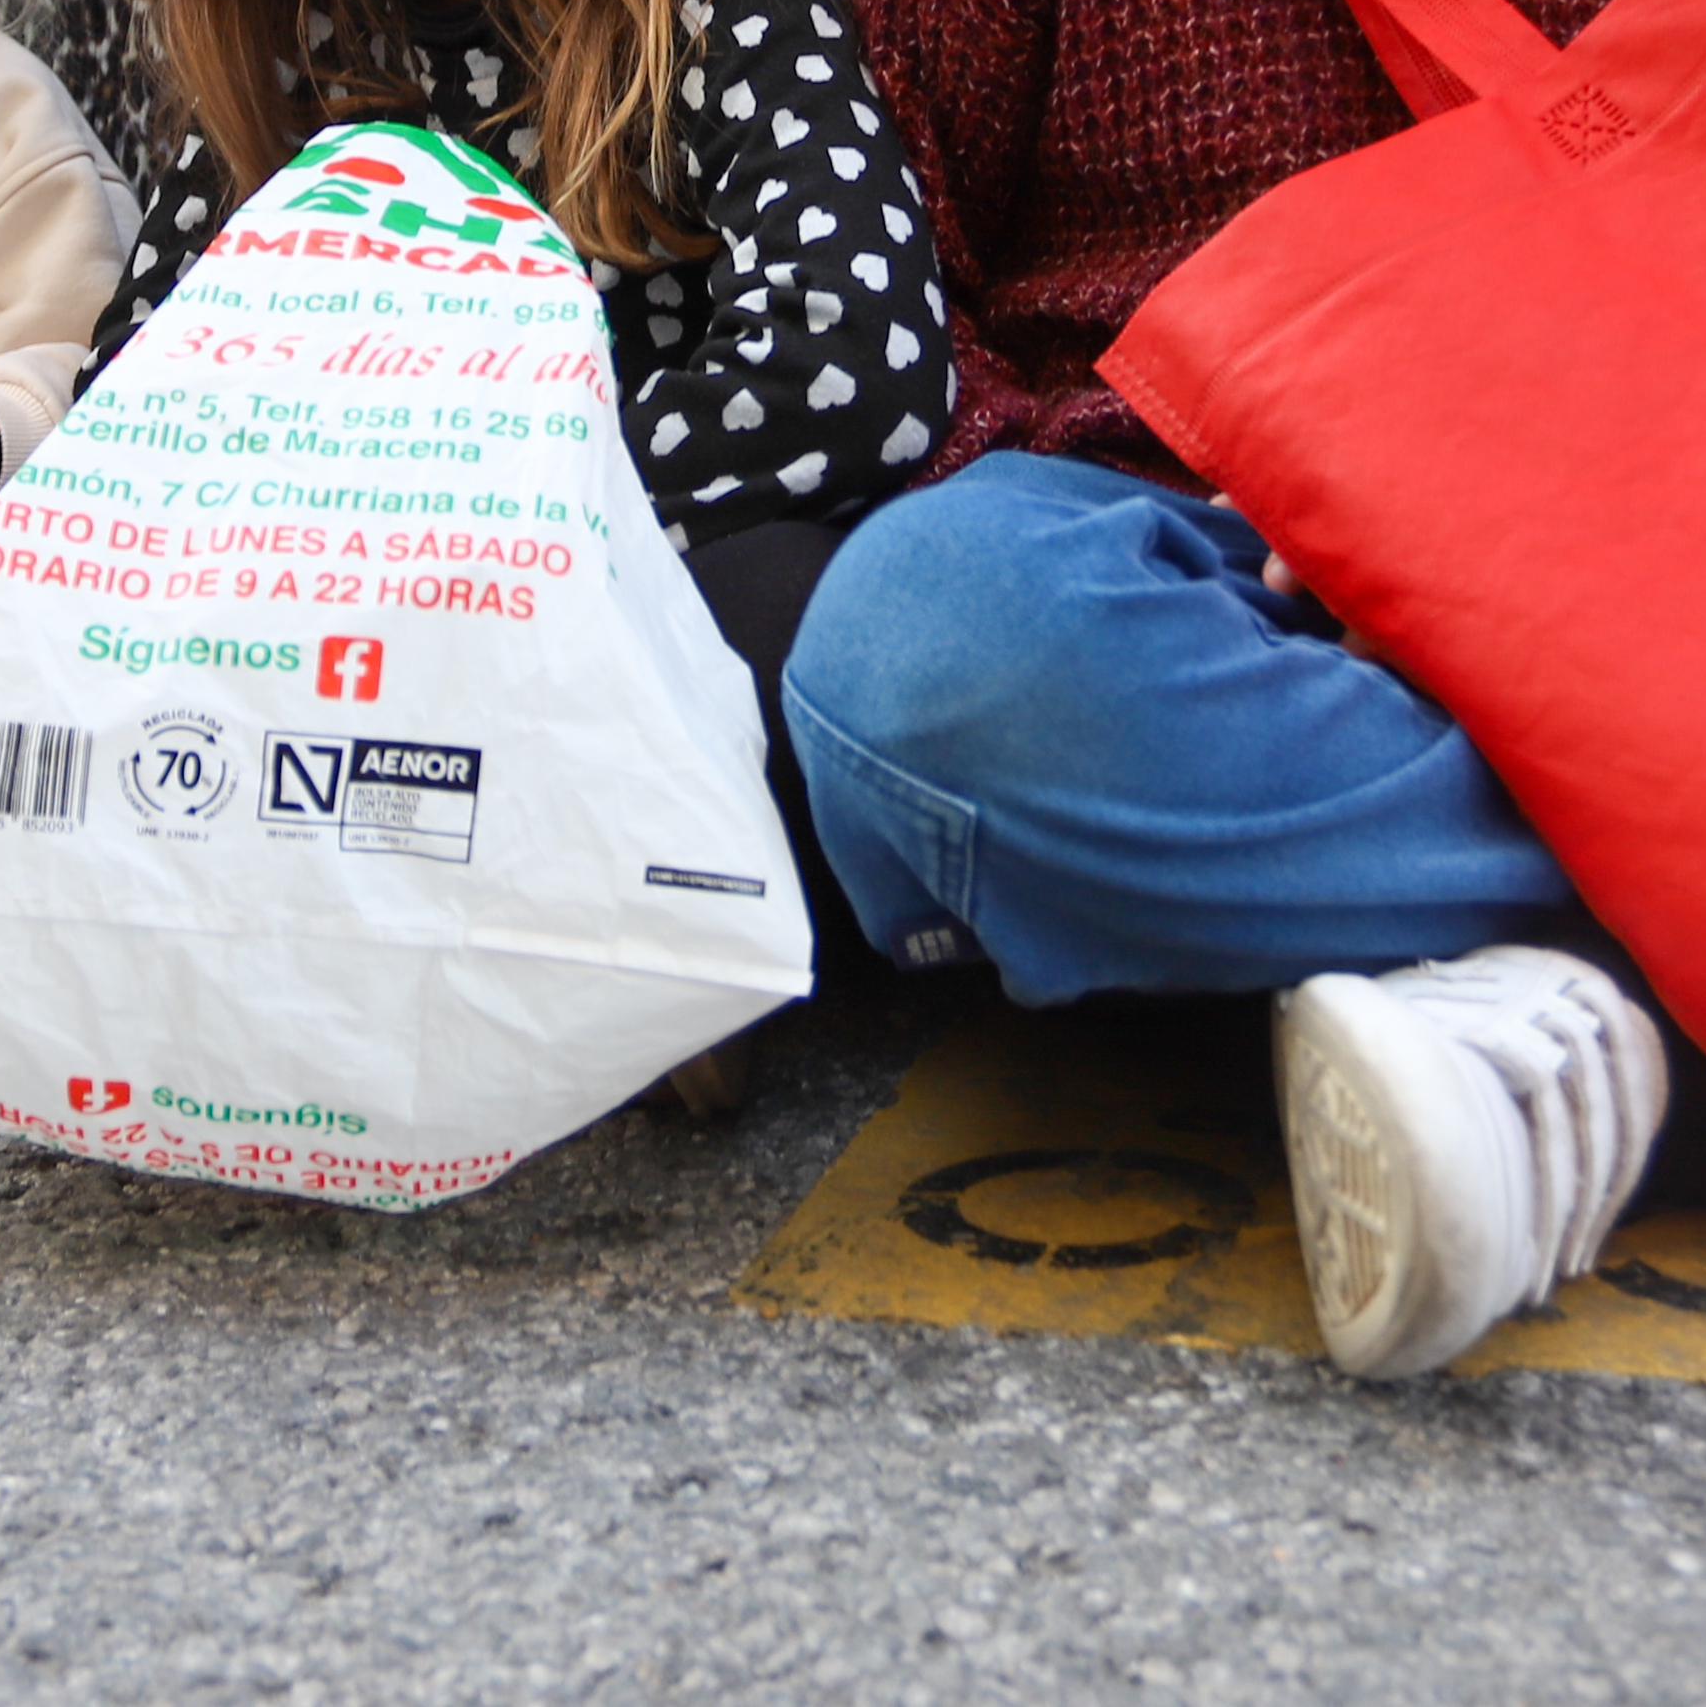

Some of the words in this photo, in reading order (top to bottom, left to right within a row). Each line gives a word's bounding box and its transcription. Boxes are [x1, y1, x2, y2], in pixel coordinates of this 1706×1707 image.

[267, 290, 359, 313] local
[373, 291, 403, 318] 6,
[422, 291, 498, 318] Telf.
[514, 301, 579, 326] 958
[165, 326, 305, 365] 365
[320, 331, 444, 377] días
[458, 344, 525, 382] al
[58, 410, 208, 454] Cerrillo
[221, 426, 270, 455] de
[283, 429, 481, 463] Maracena
[196, 394, 227, 424] 5,
[247, 394, 325, 426] Telf.
[341, 406, 411, 431] 958
[430, 407, 473, 430] 16
[486, 411, 531, 440] 25
[545, 412, 589, 442] 69
[161, 481, 184, 507] 7
[195, 479, 241, 509] C/
[250, 480, 454, 514] Churriana
[470, 490, 520, 519] de
[534, 493, 568, 523] la
[108, 520, 169, 557] DE
[181, 525, 327, 558] LUNES
[341, 530, 368, 560] A
[384, 527, 573, 578] SÁBADO
[164, 568, 221, 600] DE
[234, 568, 258, 599] 9
[270, 569, 298, 600] A
[313, 572, 362, 604] 22
[377, 575, 535, 621] HORAS
[78, 624, 301, 675] Síguenos
[359, 747, 471, 784] AENOR
[101, 1122, 147, 1145] 22
[234, 1144, 292, 1165] DE
